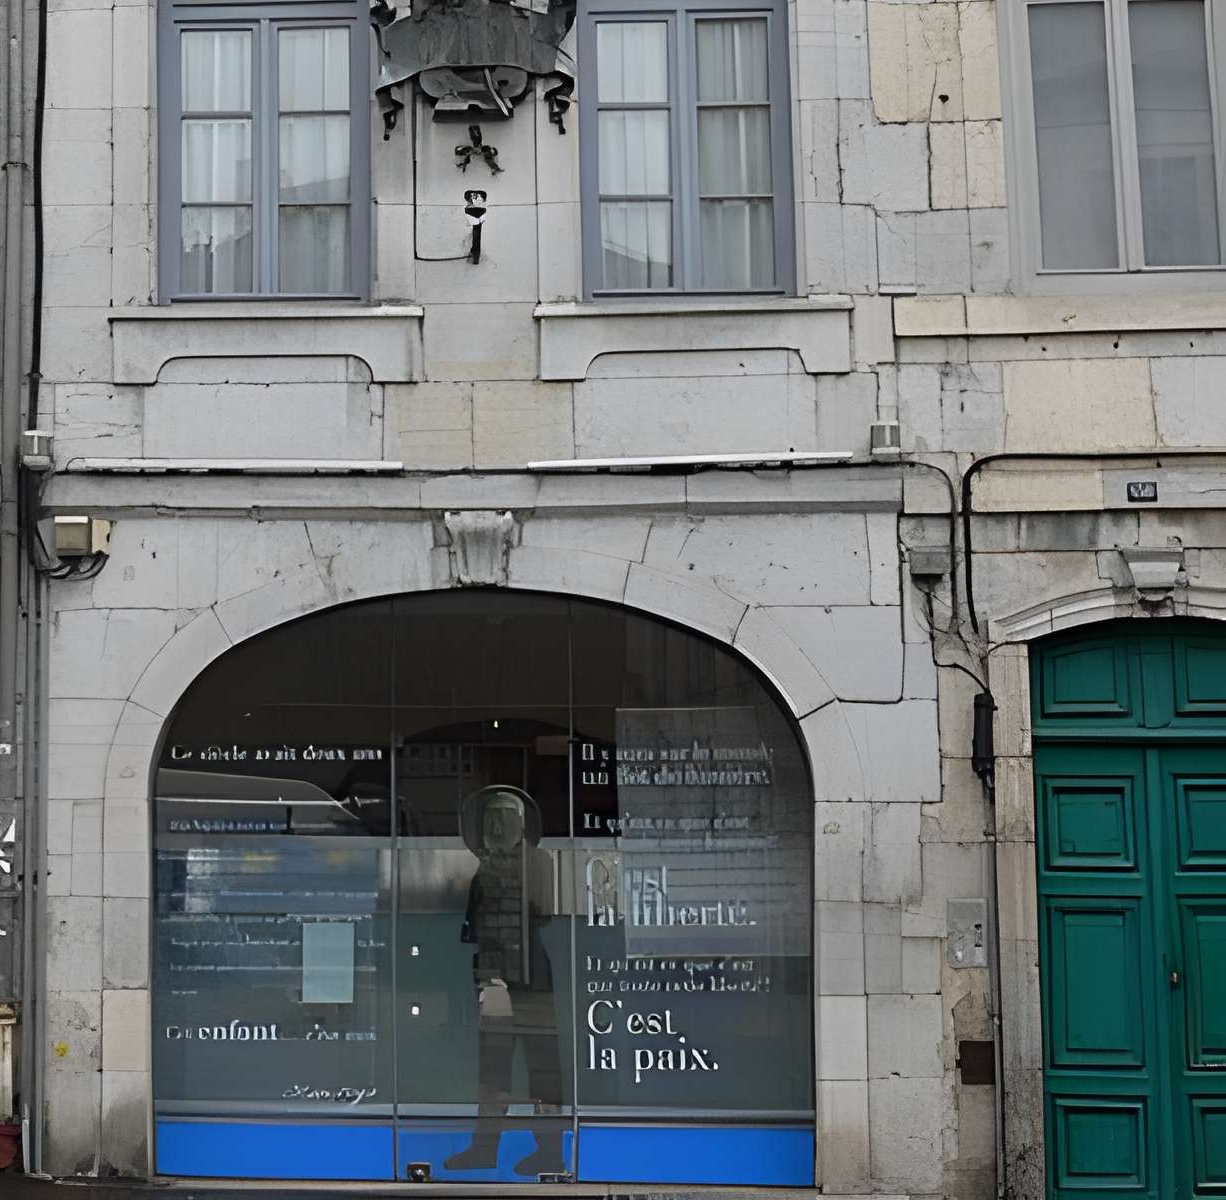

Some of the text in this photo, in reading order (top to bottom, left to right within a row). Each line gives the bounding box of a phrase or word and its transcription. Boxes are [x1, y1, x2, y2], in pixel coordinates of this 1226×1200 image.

[587, 999, 679, 1035] C'est
[586, 1033, 720, 1084] la paix.
